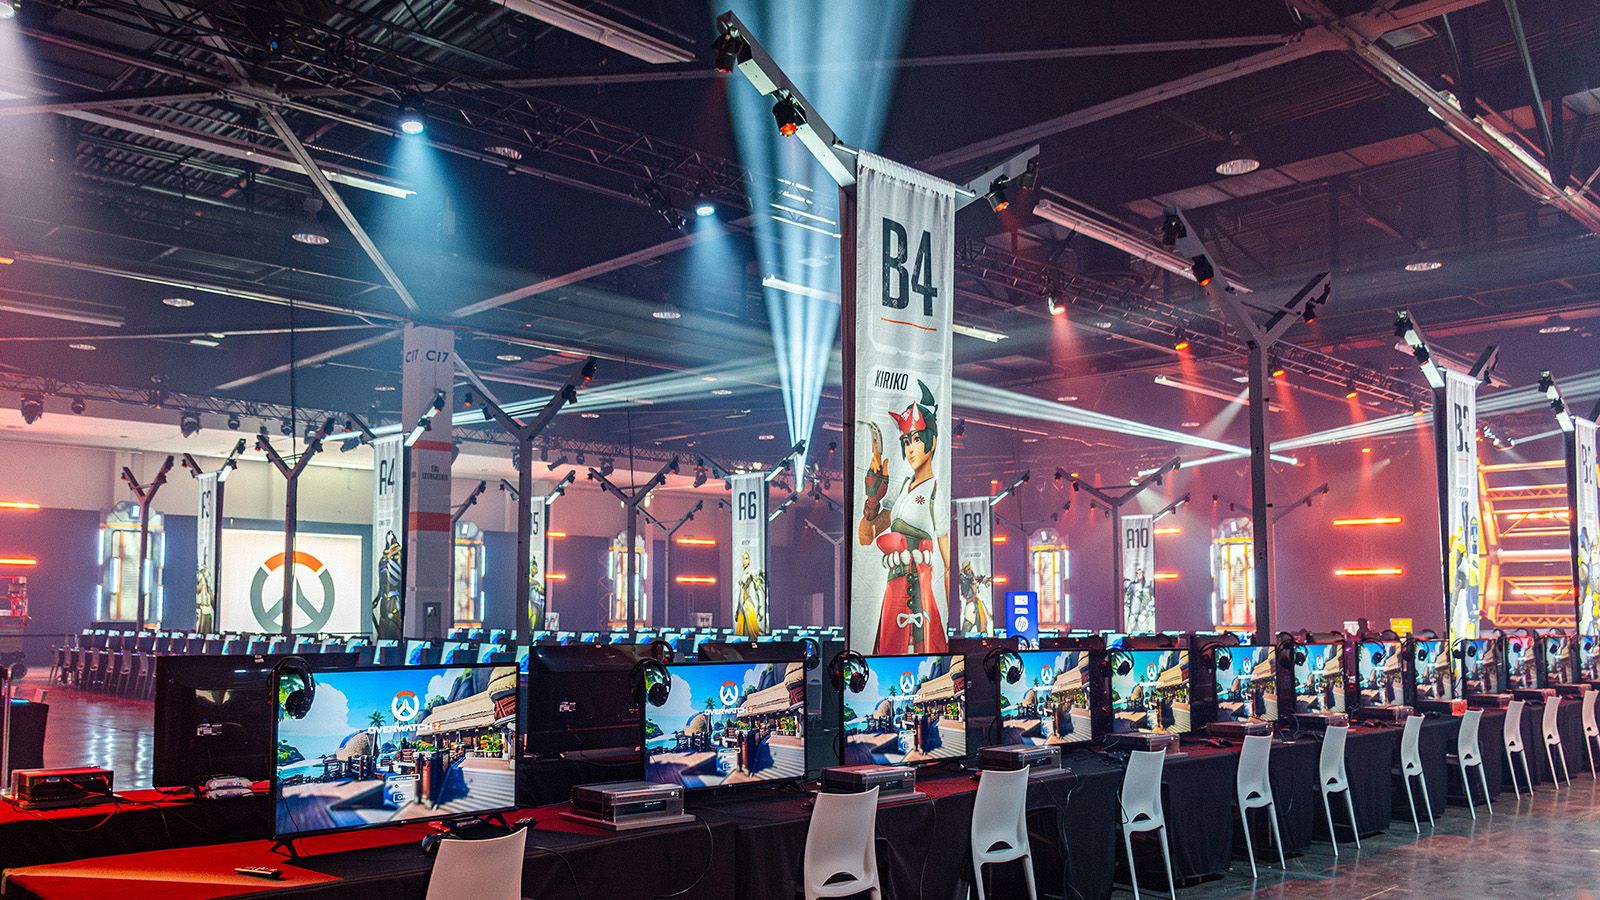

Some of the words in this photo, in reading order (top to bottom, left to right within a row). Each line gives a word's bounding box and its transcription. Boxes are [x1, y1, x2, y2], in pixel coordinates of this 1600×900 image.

[882, 217, 938, 317] B4
[875, 370, 909, 391] KIRIKO
[379, 458, 396, 495] A4
[738, 491, 757, 520] A6
[964, 512, 982, 537] A8
[1126, 527, 1149, 549] A10
[704, 706, 748, 716] OVERWATCH
[367, 723, 433, 735] OVERWATCH
[434, 722, 441, 731] 2
